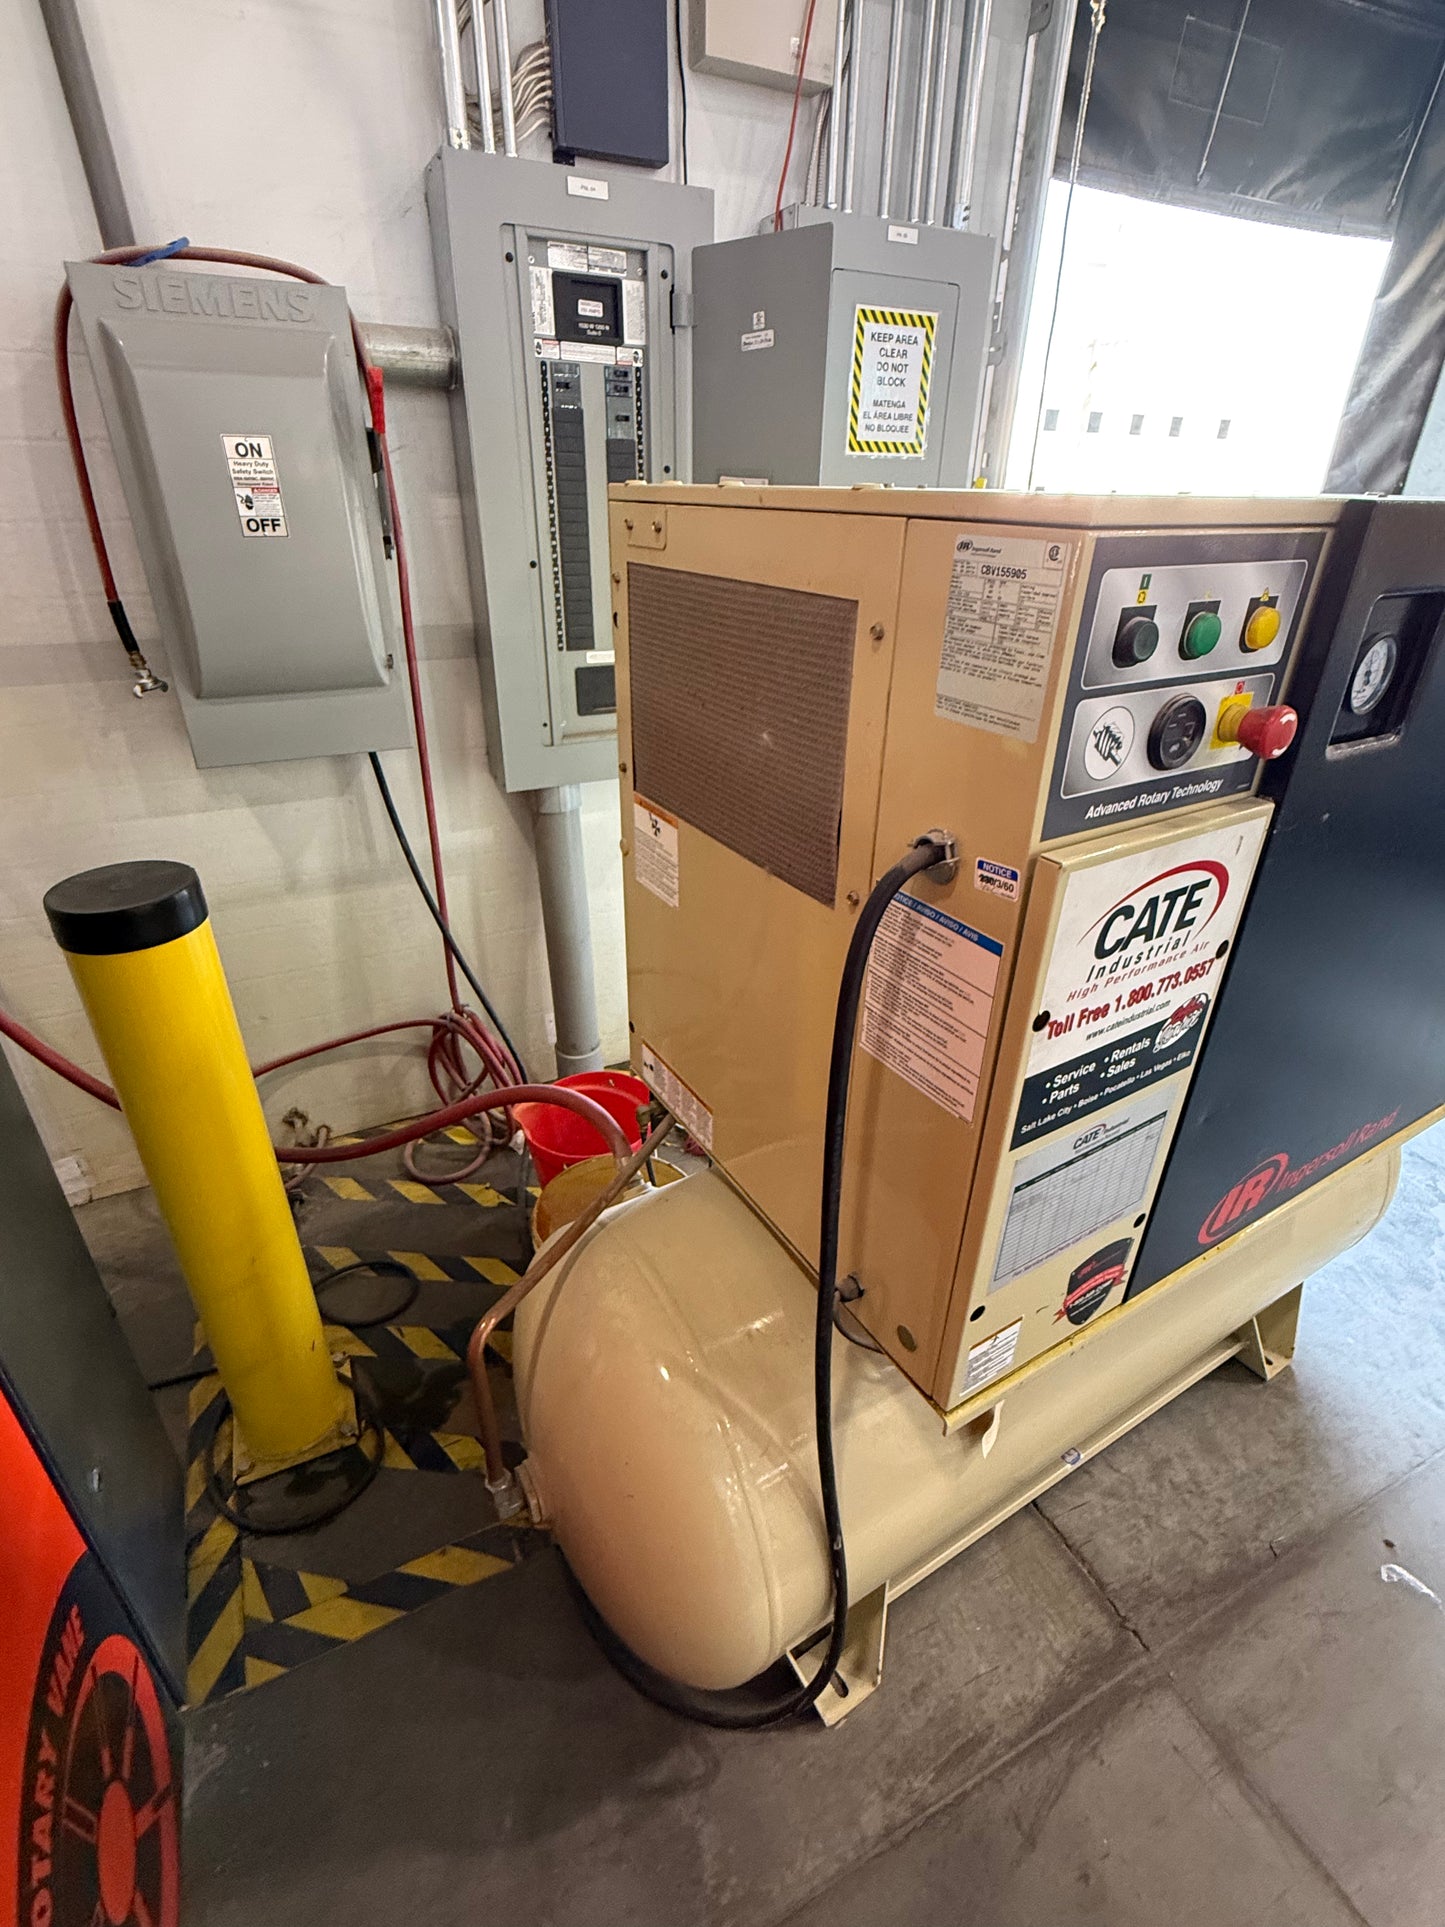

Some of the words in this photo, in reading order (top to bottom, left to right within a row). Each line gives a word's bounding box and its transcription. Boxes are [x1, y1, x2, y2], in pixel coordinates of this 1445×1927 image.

[112, 274, 315, 323] SIEMENS
[870, 331, 894, 343] KEEP
[895, 334, 919, 346] AREA
[879, 347, 908, 359] CLEAR
[876, 361, 889, 372] DO
[891, 362, 909, 374] NOT
[876, 375, 906, 388] BLOCK
[863, 411, 871, 420] EL
[893, 412, 913, 422] LIBRE
[872, 399, 906, 409] MATENGA
[864, 423, 875, 432] NO
[876, 424, 910, 434] BLOQUEE
[235, 442, 263, 458] ON
[246, 518, 281, 533] OFF
[1085, 795, 1138, 820] Advanced
[1137, 789, 1172, 807] Rotary
[1171, 779, 1224, 799] Technology
[982, 862, 1012, 879] NOTICE
[1094, 877, 1213, 960] CATE
[1066, 983, 1099, 1003] High
[1104, 951, 1187, 988] Performance
[1190, 941, 1211, 955] Air
[1085, 930, 1192, 983] Industrial
[1047, 1012, 1075, 1040] Toll
[1077, 1004, 1110, 1029] Free
[1115, 957, 1216, 1012] 1.800.773.0557
[1085, 1000, 1172, 1041] www.cateindustrial.com
[1053, 1061, 1097, 1088] Service
[1110, 1037, 1151, 1064] Rentals
[1020, 1121, 1037, 1134] Salt
[1037, 1113, 1057, 1126] Lake
[1057, 1105, 1073, 1117] City
[1077, 1093, 1099, 1108] Boise
[1103, 1076, 1136, 1096] Pocatello
[1140, 1068, 1153, 1079] Las
[1153, 1058, 1173, 1073] Vegas
[1049, 1082, 1080, 1104] Parts
[1107, 1057, 1137, 1079] Sales
[1073, 1128, 1102, 1150] CATE
[1206, 1163, 1278, 1236] IR
[1274, 1129, 1358, 1195] Ingersoll
[1353, 1103, 1402, 1144] Rand
